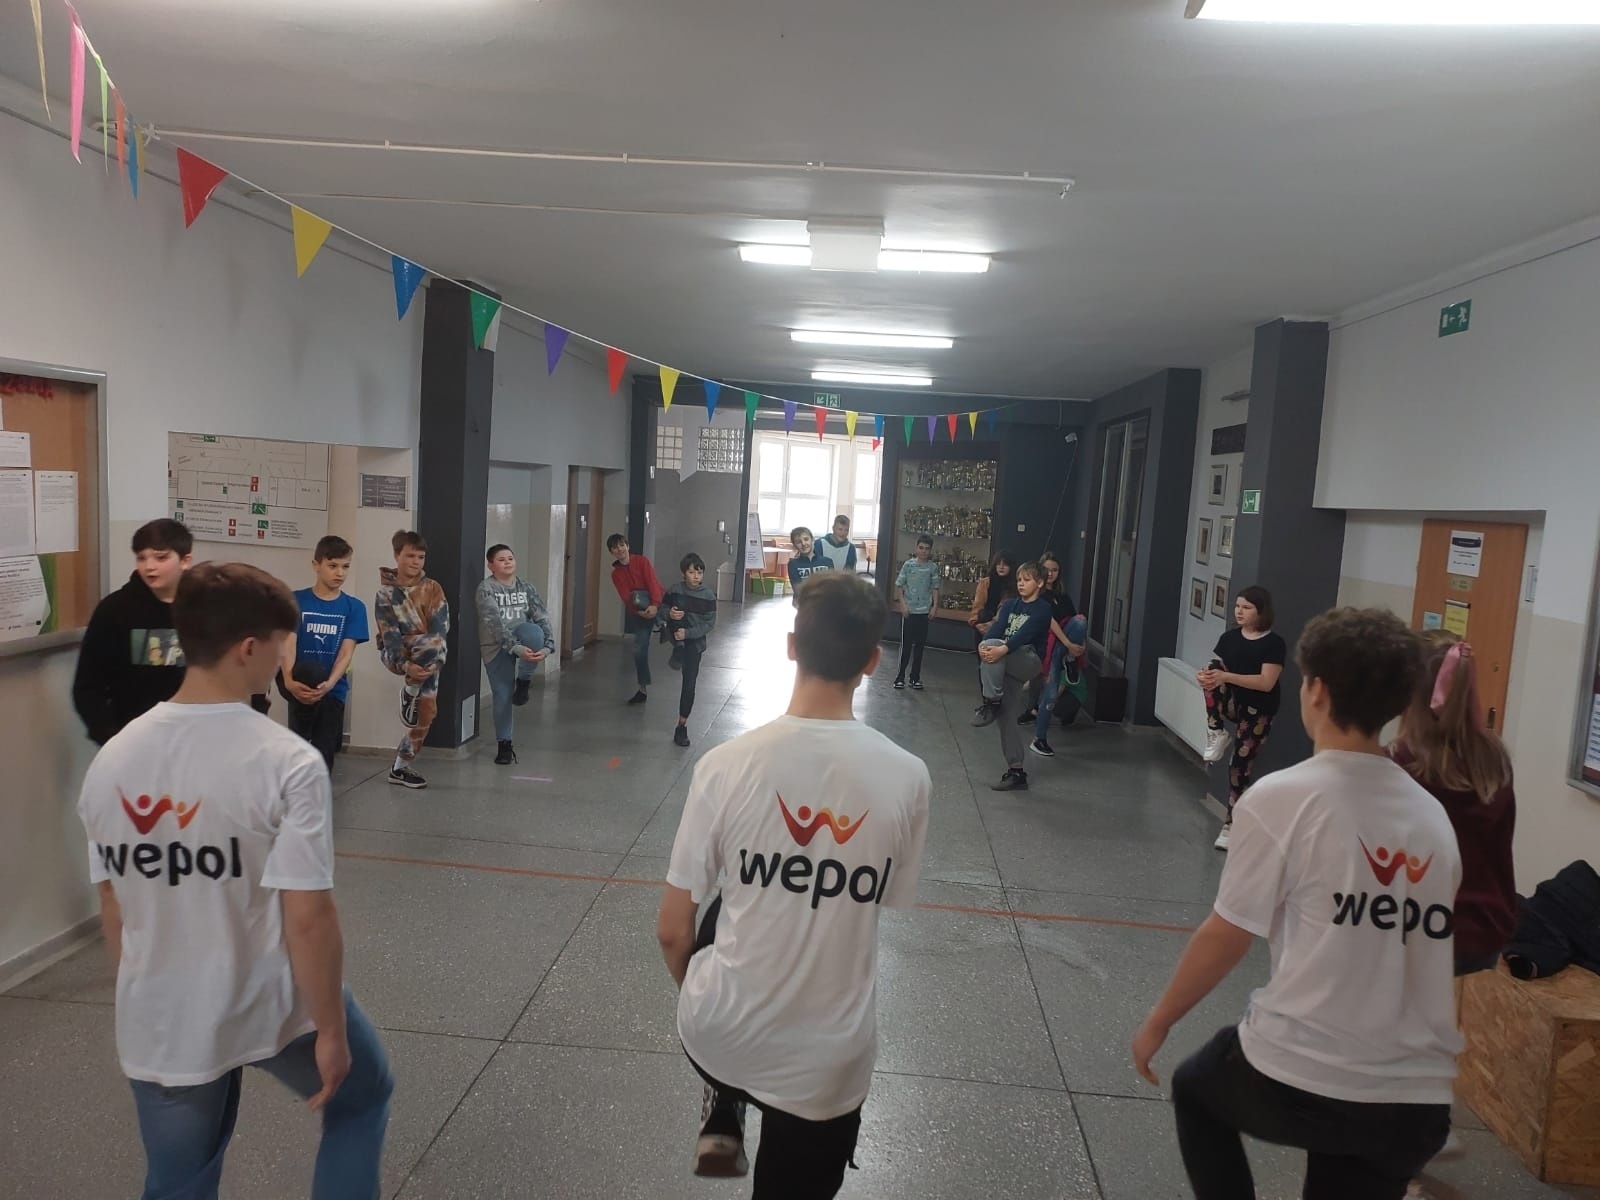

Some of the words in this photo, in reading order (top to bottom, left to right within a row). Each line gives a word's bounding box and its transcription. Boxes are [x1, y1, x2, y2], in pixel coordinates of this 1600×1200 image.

[306, 623, 338, 635] PUMA
[97, 837, 242, 886] wepol
[740, 849, 892, 909] wepol
